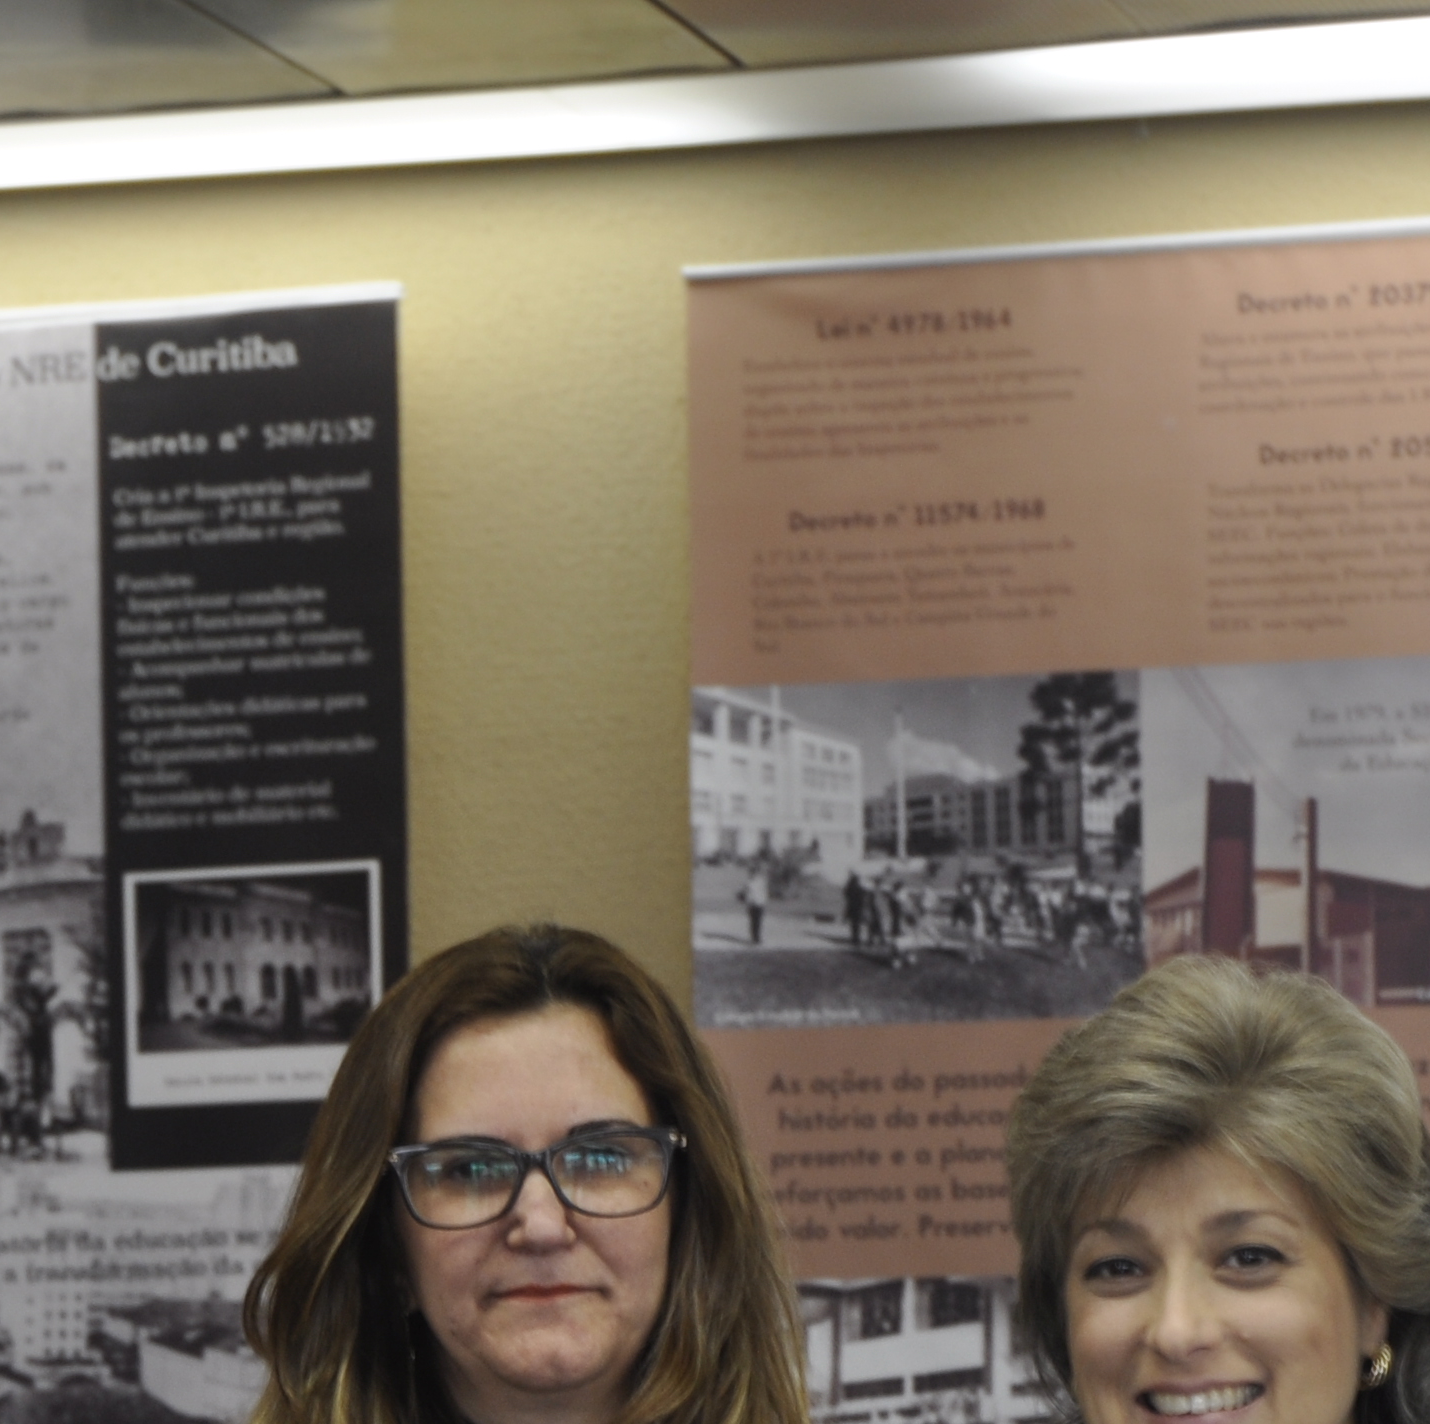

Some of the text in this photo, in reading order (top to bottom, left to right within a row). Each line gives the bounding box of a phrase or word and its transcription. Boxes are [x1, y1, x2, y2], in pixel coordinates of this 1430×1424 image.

[8, 350, 88, 387] NRE
[95, 344, 141, 383] de
[147, 336, 298, 377] Curitiba
[935, 1065, 1027, 1099] passad
[927, 1102, 1007, 1127] educa
